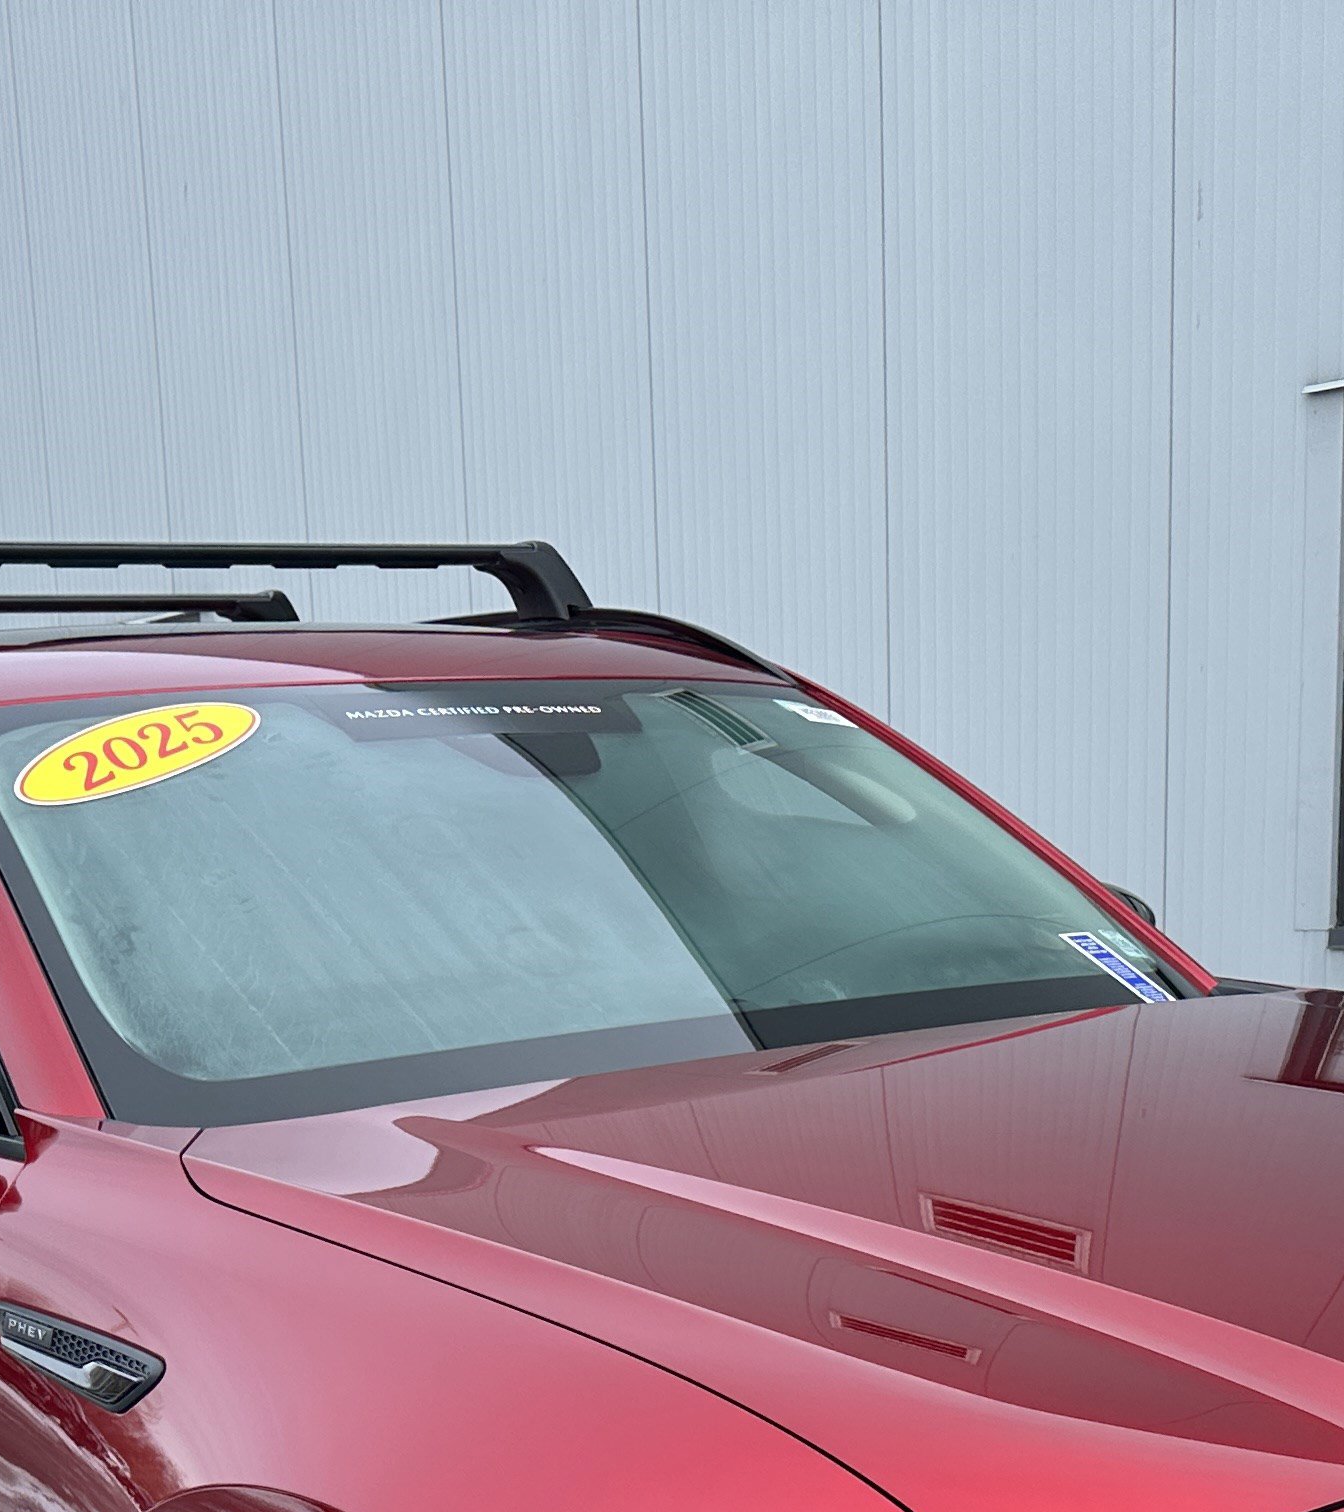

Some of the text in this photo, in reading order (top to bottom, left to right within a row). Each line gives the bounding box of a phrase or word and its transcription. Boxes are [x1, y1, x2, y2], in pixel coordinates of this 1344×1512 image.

[345, 705, 602, 720] MAZDA CERTIFIED PRE-OWNED
[63, 709, 224, 791] 2025
[7, 1318, 47, 1341] PHEV
